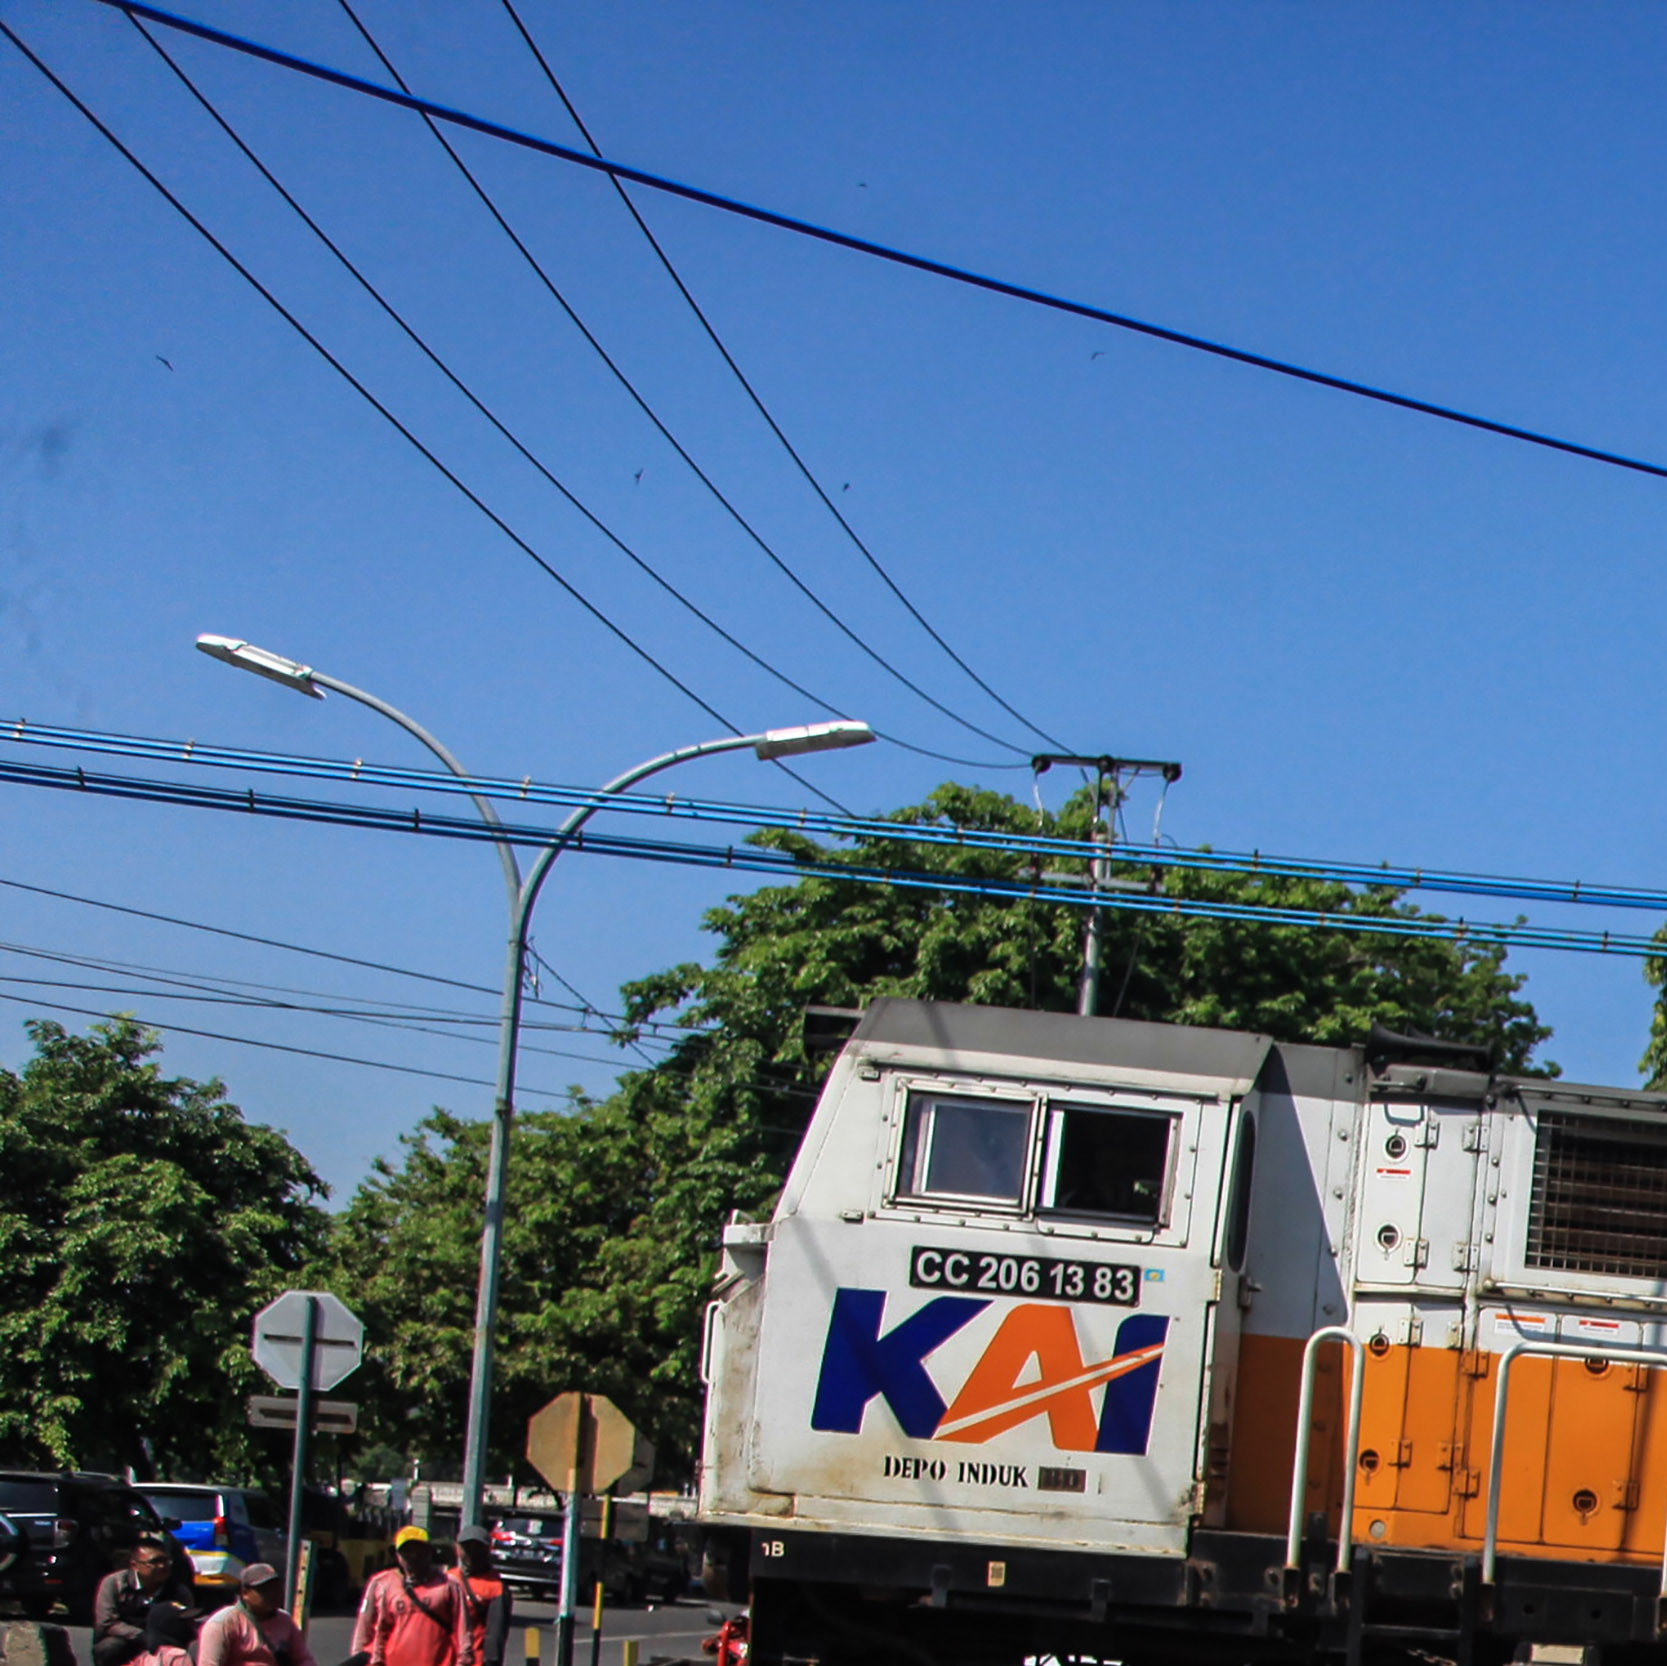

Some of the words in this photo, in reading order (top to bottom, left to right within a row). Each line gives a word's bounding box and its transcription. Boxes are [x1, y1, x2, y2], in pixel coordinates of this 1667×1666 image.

[916, 1251, 970, 1286] CC
[977, 1256, 1041, 1293] 206
[1050, 1263, 1085, 1297] 13
[1093, 1267, 1134, 1301] 83
[810, 1287, 1170, 1456] KAI
[883, 1455, 947, 1481] DEPO
[957, 1461, 1029, 1488] INDUK
[761, 1540, 785, 1558] 1B
